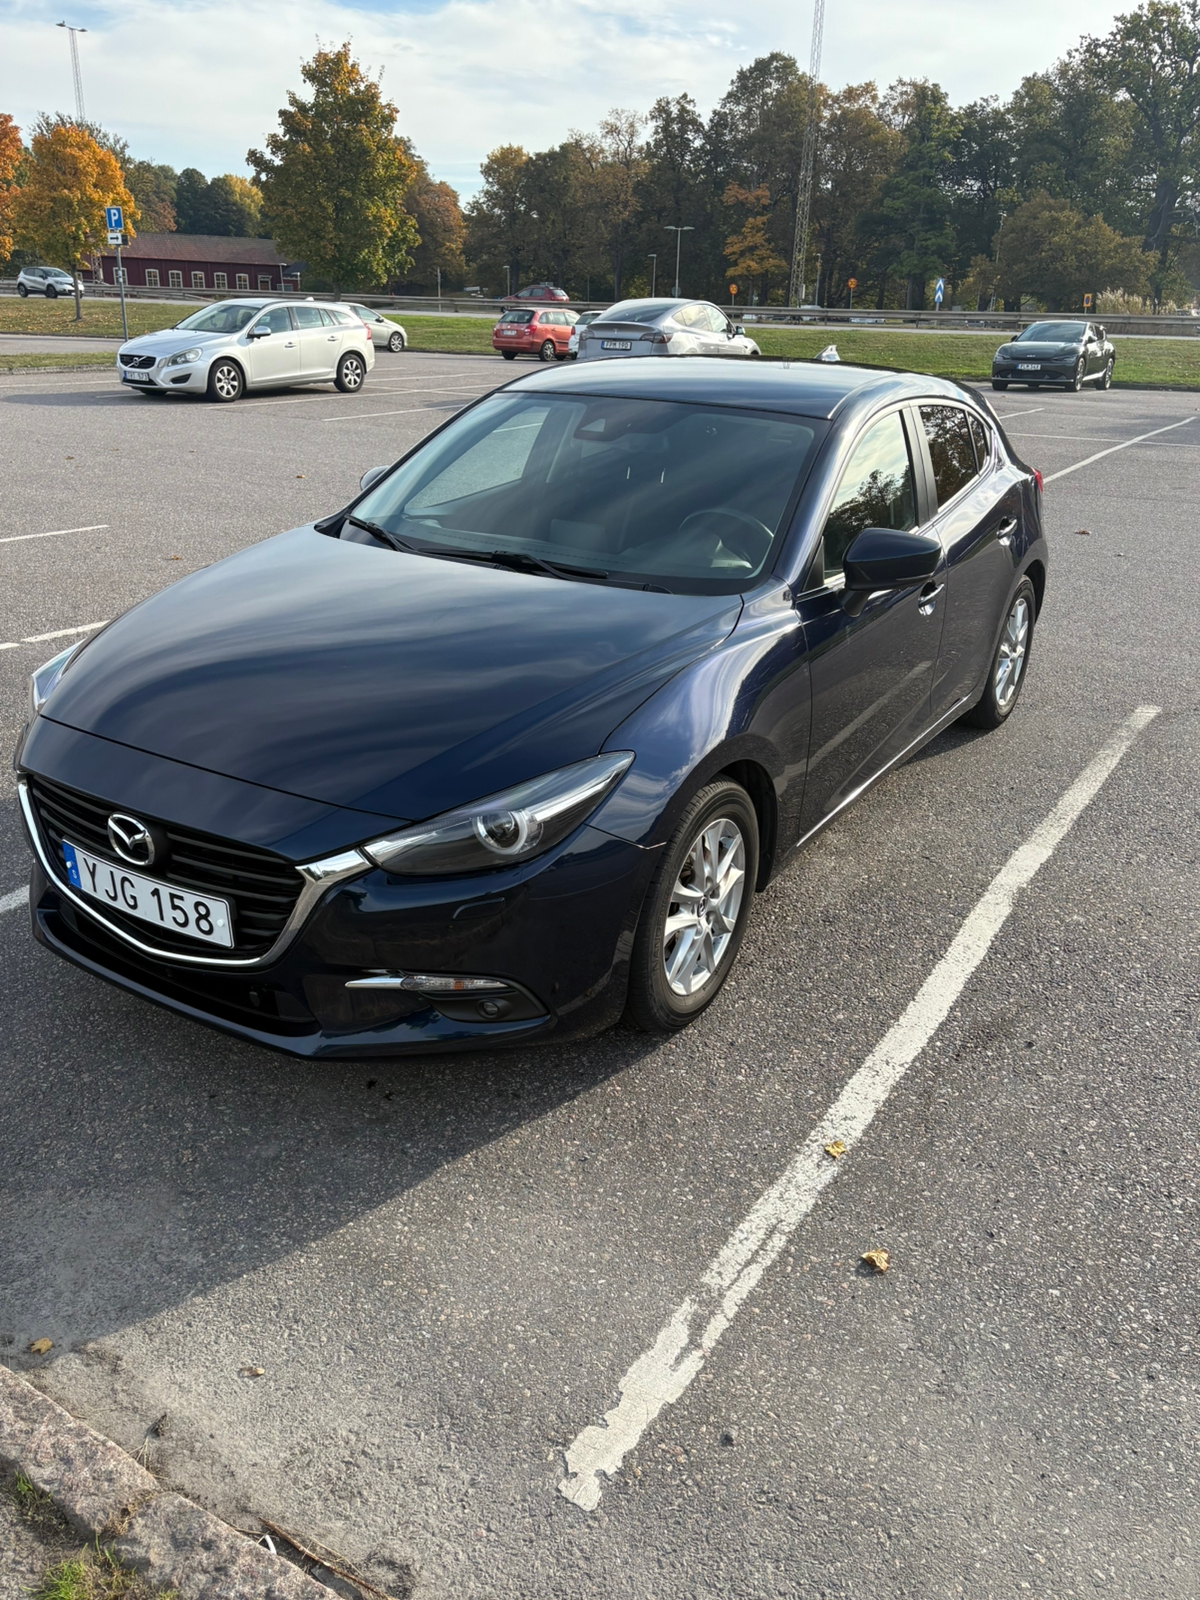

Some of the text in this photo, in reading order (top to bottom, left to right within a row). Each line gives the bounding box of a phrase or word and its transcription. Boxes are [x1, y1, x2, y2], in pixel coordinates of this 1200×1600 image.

[110, 209, 119, 227] P
[83, 857, 214, 936] YJG 158
